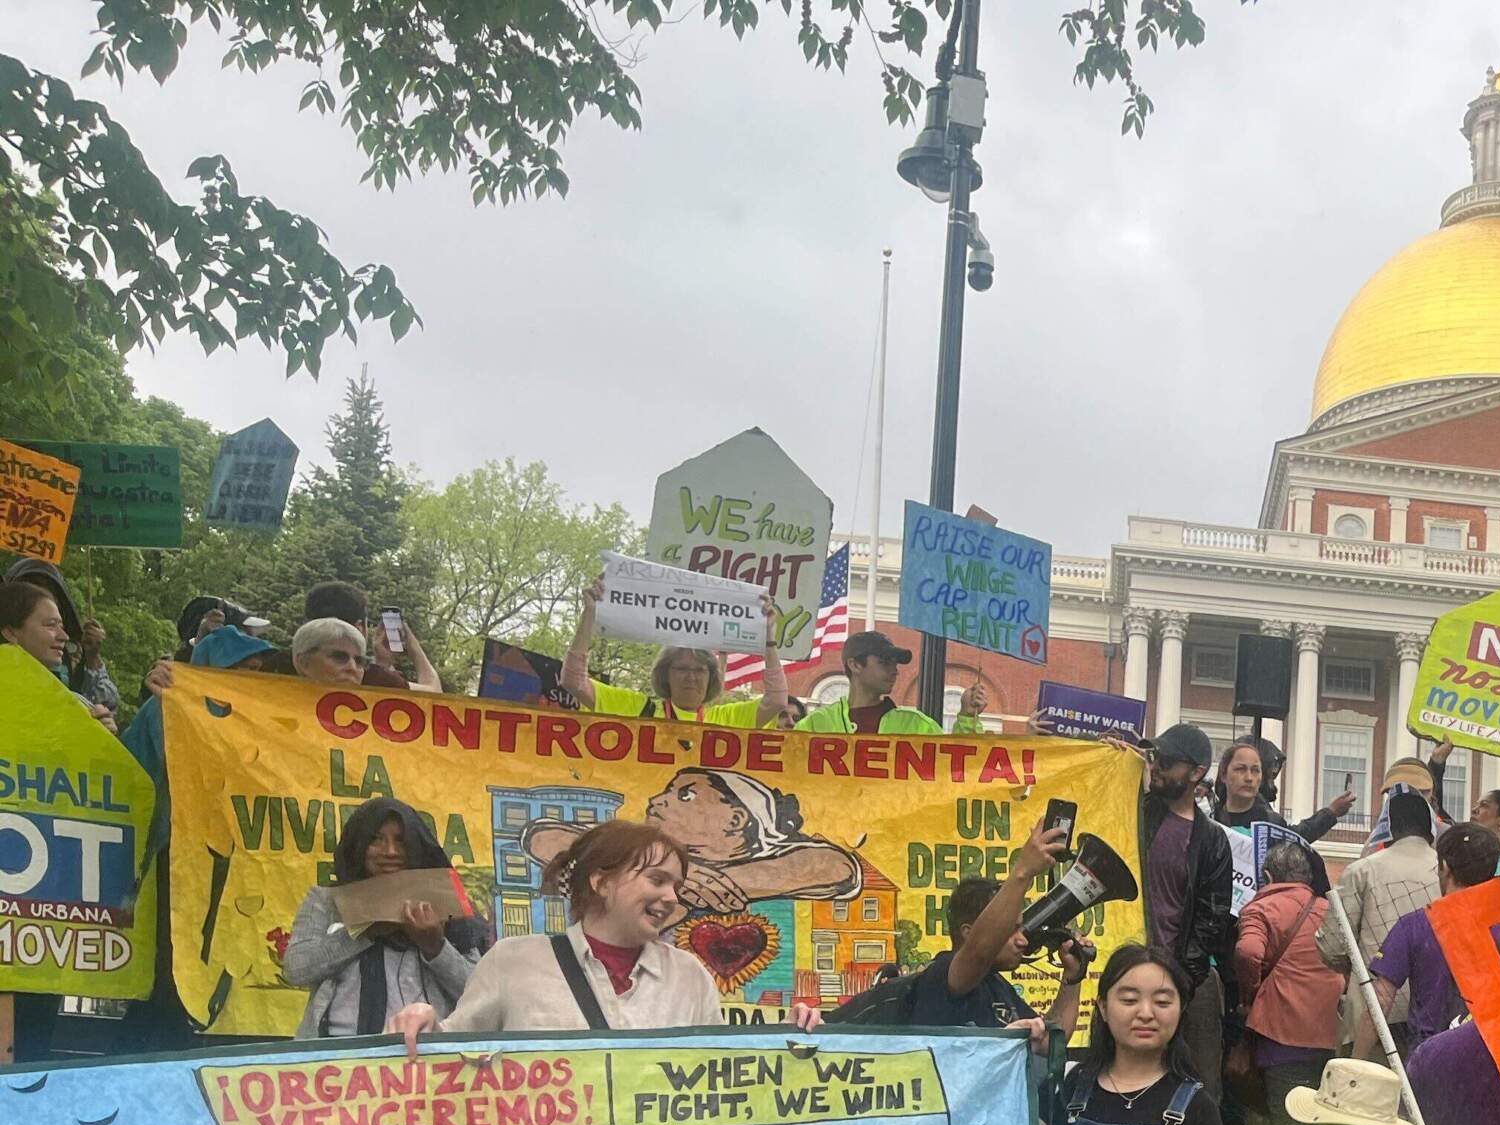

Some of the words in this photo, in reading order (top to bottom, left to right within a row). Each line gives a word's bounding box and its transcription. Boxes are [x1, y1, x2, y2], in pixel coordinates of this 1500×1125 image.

[680, 486, 753, 544] WE
[753, 503, 816, 546] have
[687, 545, 816, 600] RIGHT
[911, 515, 996, 560] RAISE
[1000, 544, 1050, 586] OUR
[610, 590, 660, 609] RENT
[664, 596, 755, 619] CONTROL
[655, 616, 709, 635] NOW!
[986, 597, 1036, 627] OUR
[941, 608, 1017, 653] RENT
[316, 692, 675, 764] CONTROL
[700, 730, 784, 773] DE
[807, 736, 1037, 786] RENTA!
[1082, 714, 1100, 724] MY
[1102, 717, 1135, 732] WAGE
[0, 759, 129, 813] SHALL
[330, 748, 394, 799] LA
[957, 798, 1010, 840] UN
[0, 812, 123, 902] OT
[31, 903, 112, 924] URBANA
[656, 1054, 783, 1092] WHEN
[813, 1057, 876, 1086] WE
[634, 1092, 754, 1124] FIGHT,
[774, 1086, 830, 1118] WE
[841, 1078, 923, 1116] WIN!
